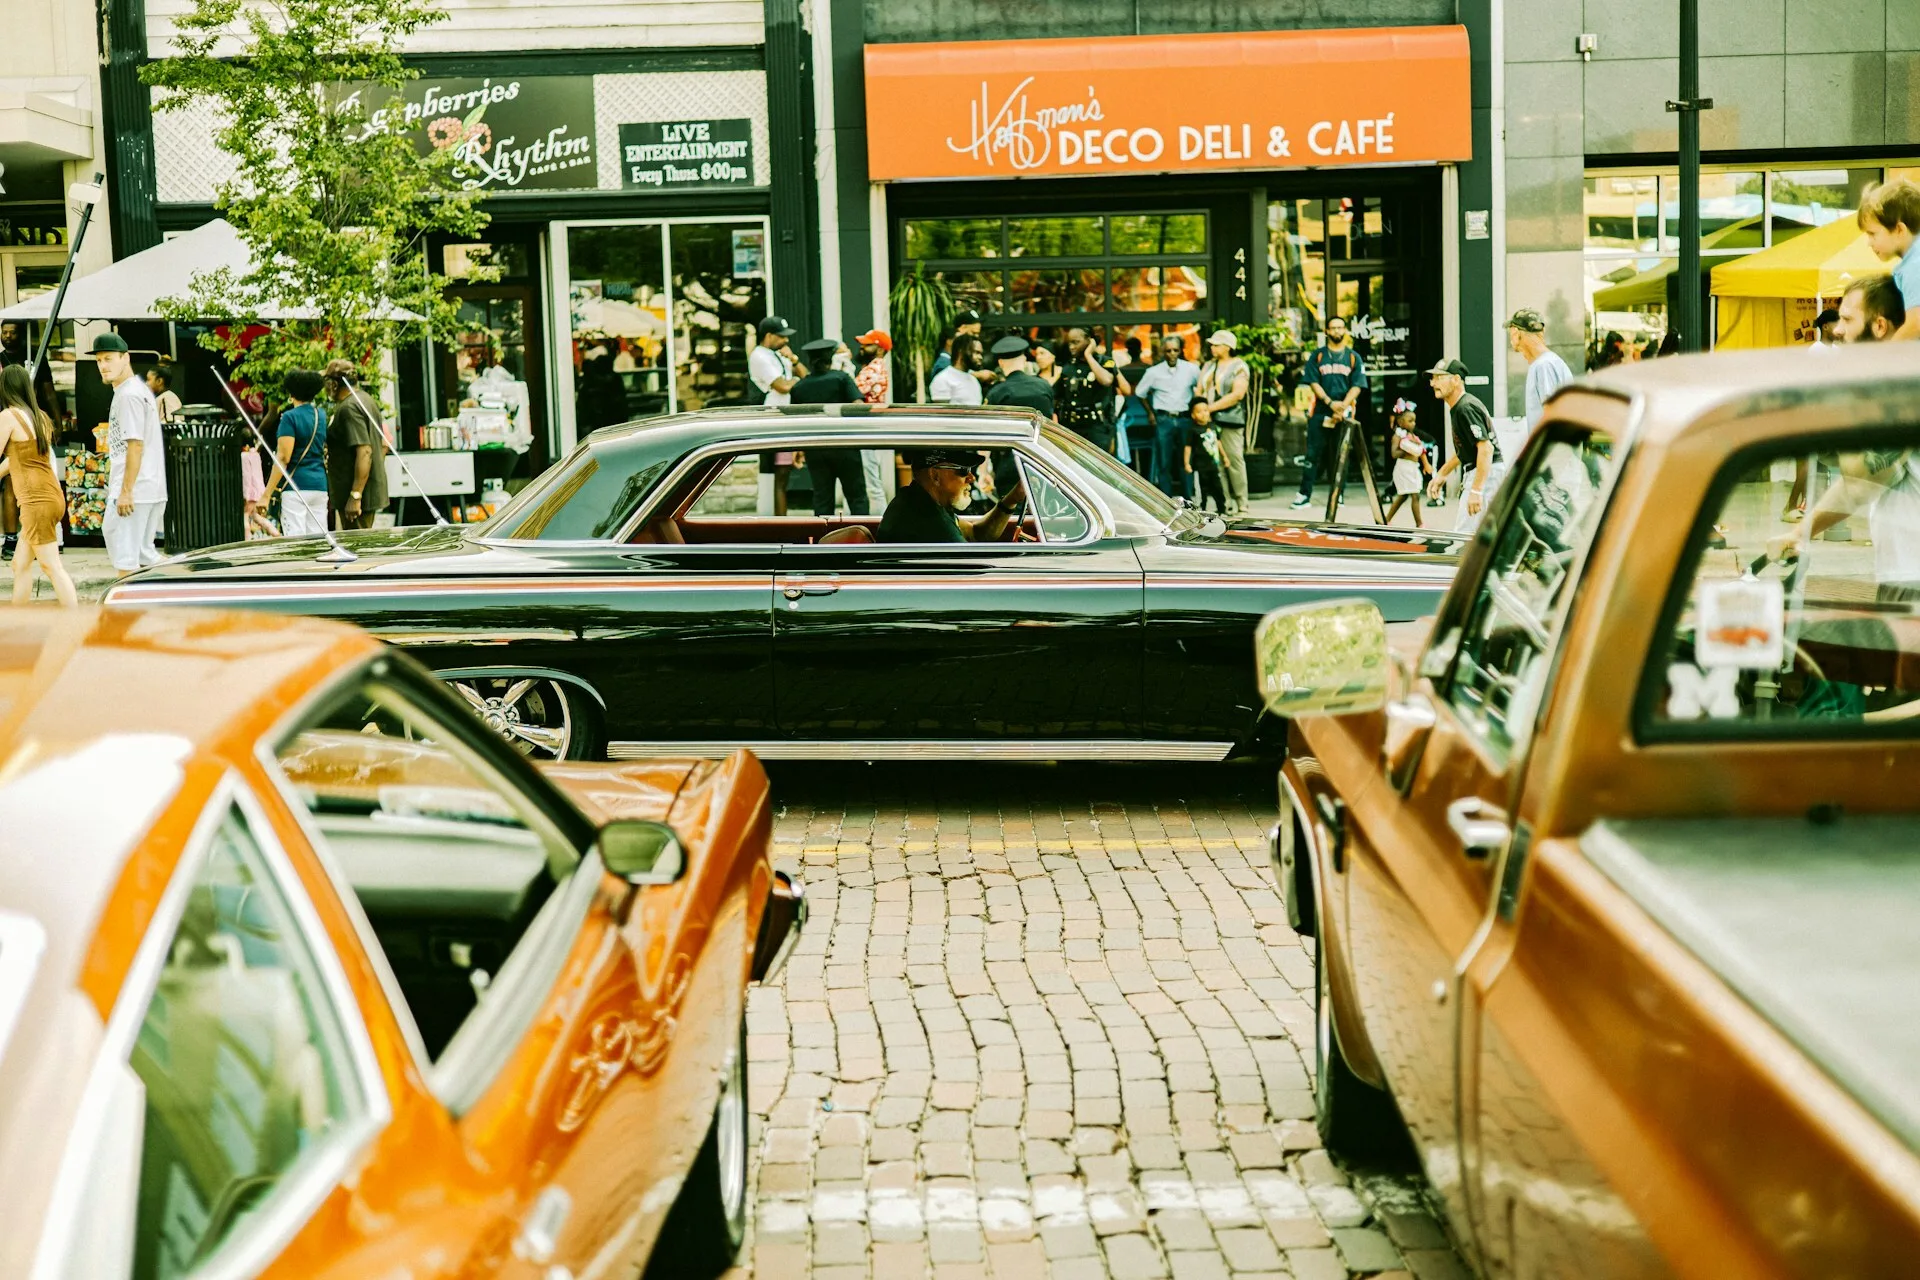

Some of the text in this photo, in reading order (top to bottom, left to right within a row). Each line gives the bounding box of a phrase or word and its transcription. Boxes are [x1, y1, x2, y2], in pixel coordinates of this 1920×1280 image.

[334, 78, 520, 146] Rapberries
[625, 140, 748, 162] ENTERTAINMENT
[661, 123, 711, 142] LIVE
[1059, 112, 1395, 165] DECO DELI & CAFÉ
[451, 125, 591, 191] Rhythm
[631, 165, 663, 186] Every
